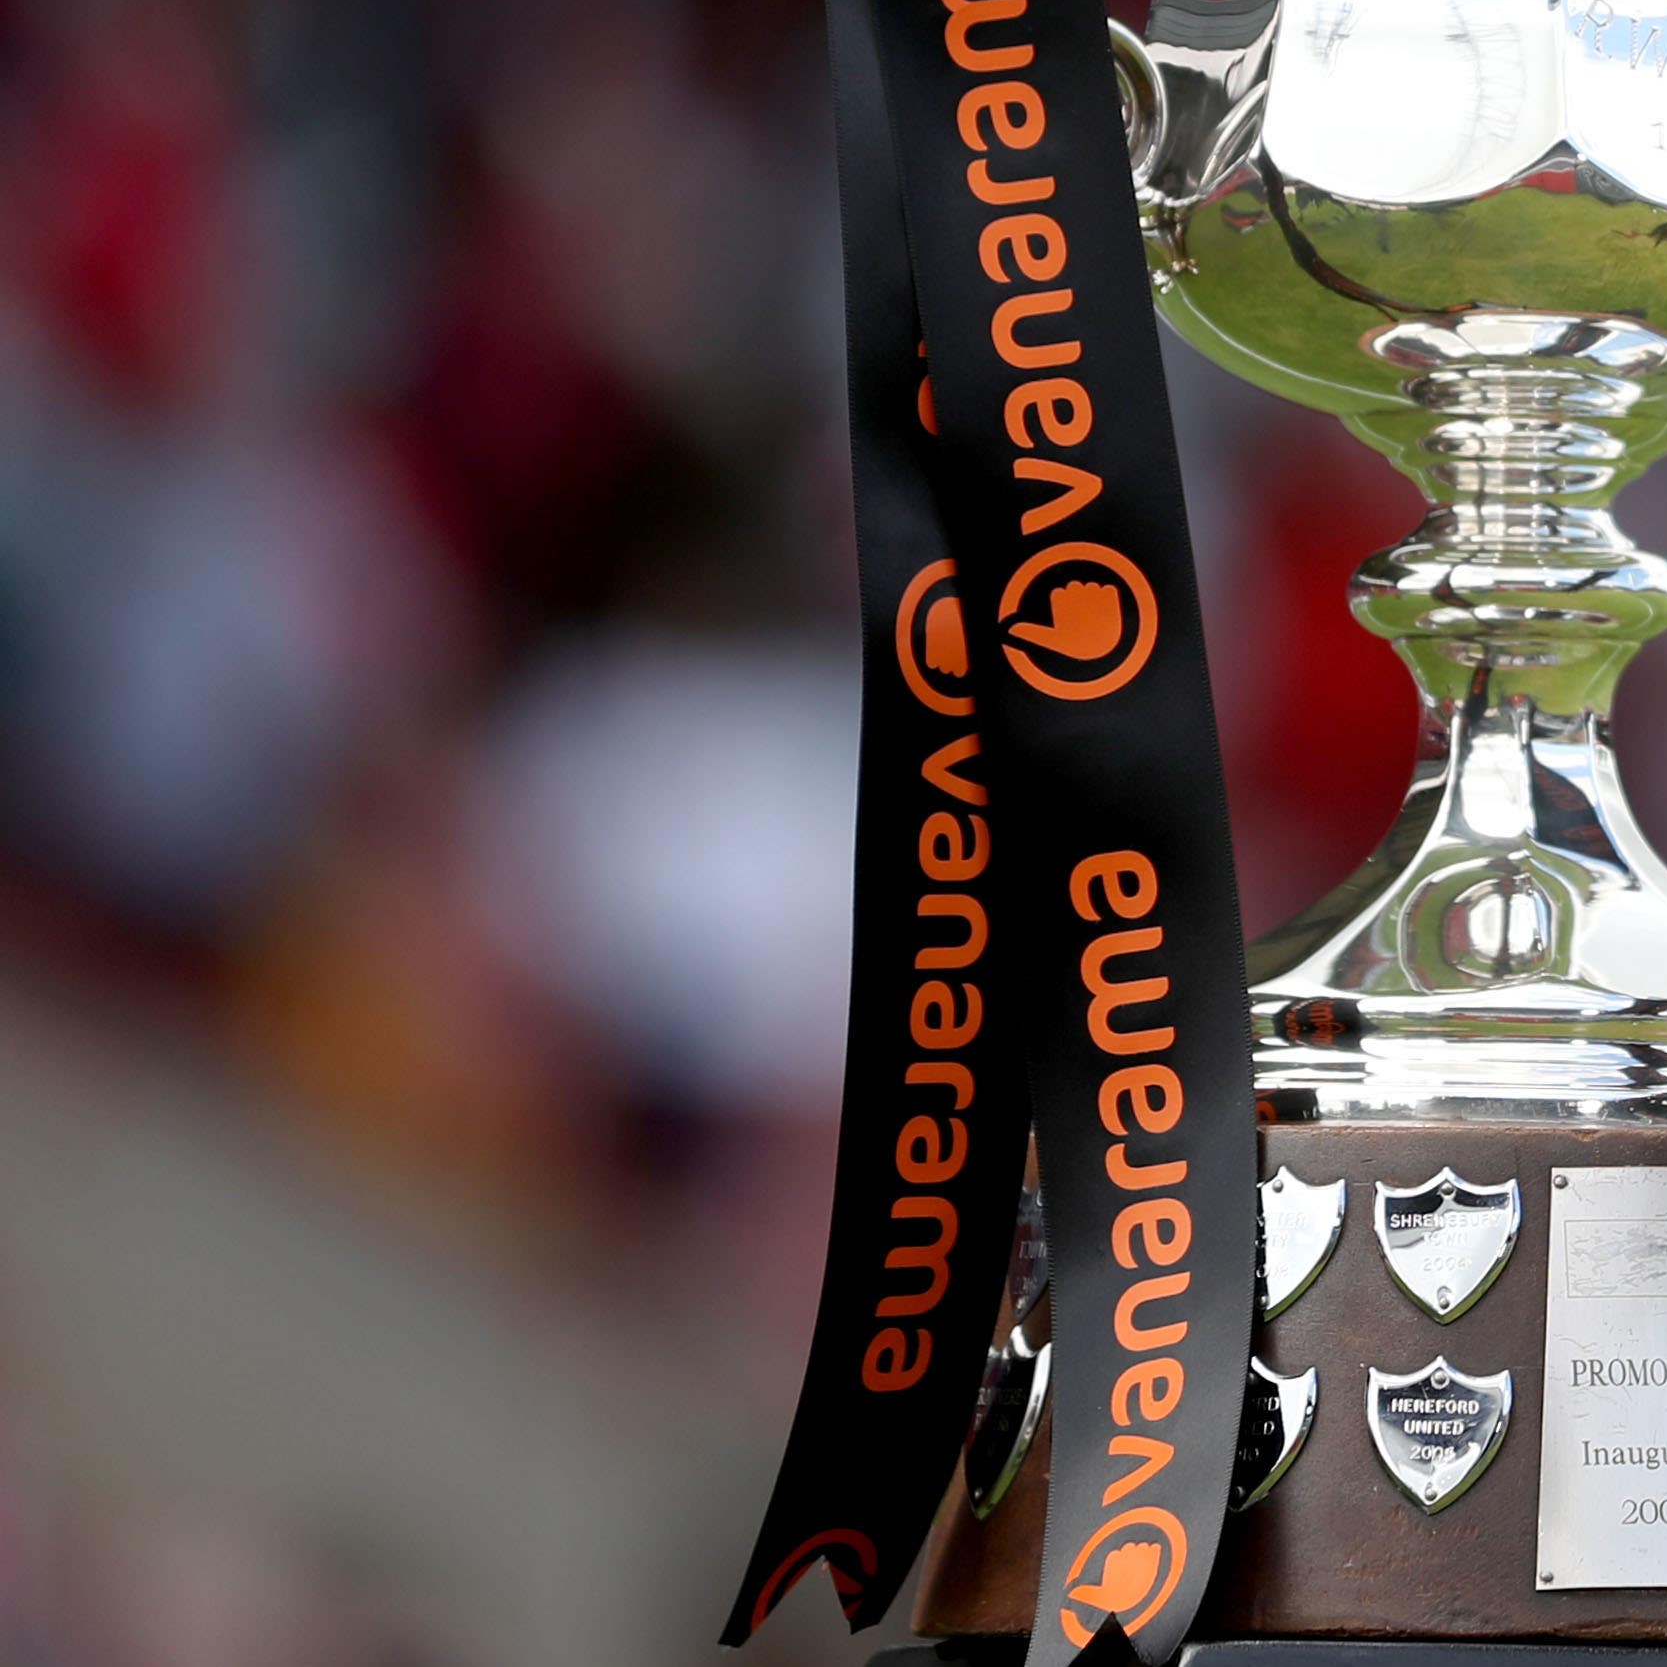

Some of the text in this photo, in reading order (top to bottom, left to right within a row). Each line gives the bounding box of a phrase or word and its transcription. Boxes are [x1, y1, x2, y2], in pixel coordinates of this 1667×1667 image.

[861, 734, 990, 1393] vanarama
[1068, 849, 1194, 1507] vanarama
[1389, 1213, 1502, 1230] SHREWSBURY
[1390, 1397, 1481, 1415] HEREFORD
[1403, 1418, 1466, 1436] UNITED
